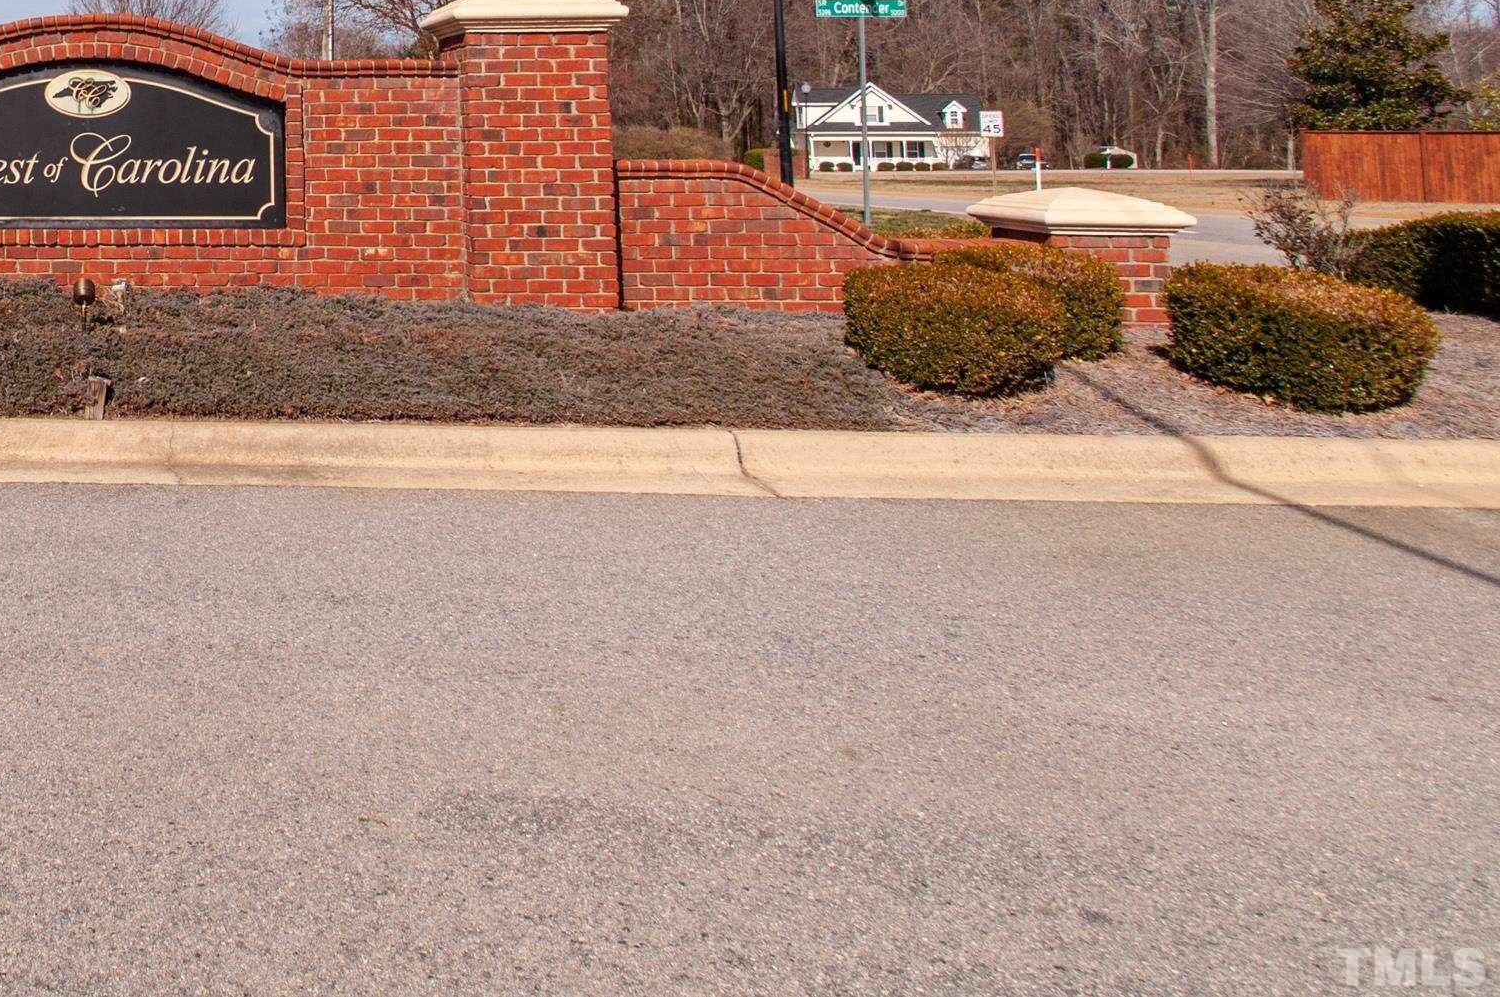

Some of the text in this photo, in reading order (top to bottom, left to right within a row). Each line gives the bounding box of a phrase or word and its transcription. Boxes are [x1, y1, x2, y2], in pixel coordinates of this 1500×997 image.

[834, 1, 889, 13] Contender
[983, 124, 1001, 134] 45
[43, 156, 68, 182] of
[70, 132, 256, 198] Carolina
